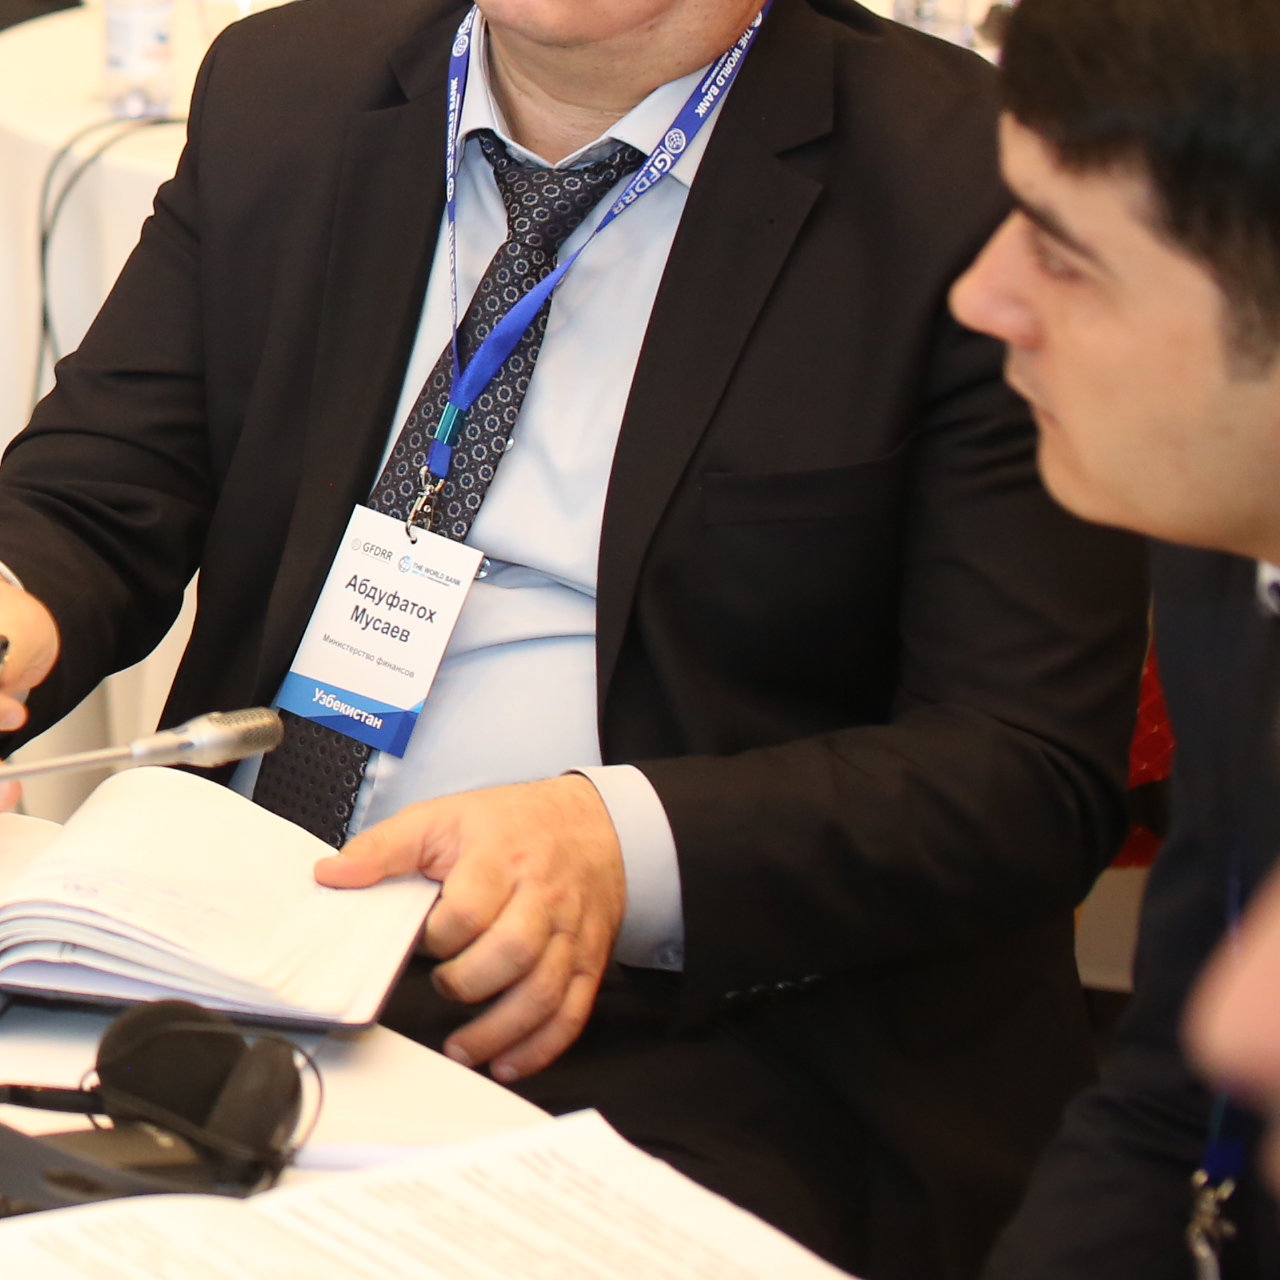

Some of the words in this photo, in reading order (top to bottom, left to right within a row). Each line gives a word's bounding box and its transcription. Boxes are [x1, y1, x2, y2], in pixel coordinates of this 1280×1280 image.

[738, 29, 753, 49] THE
[716, 47, 742, 86] WORLD
[449, 77, 458, 109] BANK
[695, 84, 719, 118] BANK
[612, 152, 672, 215] GFDRR
[362, 542, 394, 562] GFDRR
[413, 562, 423, 571] THE
[424, 567, 444, 580] WORLD
[445, 575, 462, 586] BANK
[345, 574, 438, 624] Абдуфатох
[350, 604, 411, 643] Мусаев
[322, 633, 375, 662] Министерство
[376, 657, 415, 679] финансов
[312, 687, 383, 730] Узбекистан
